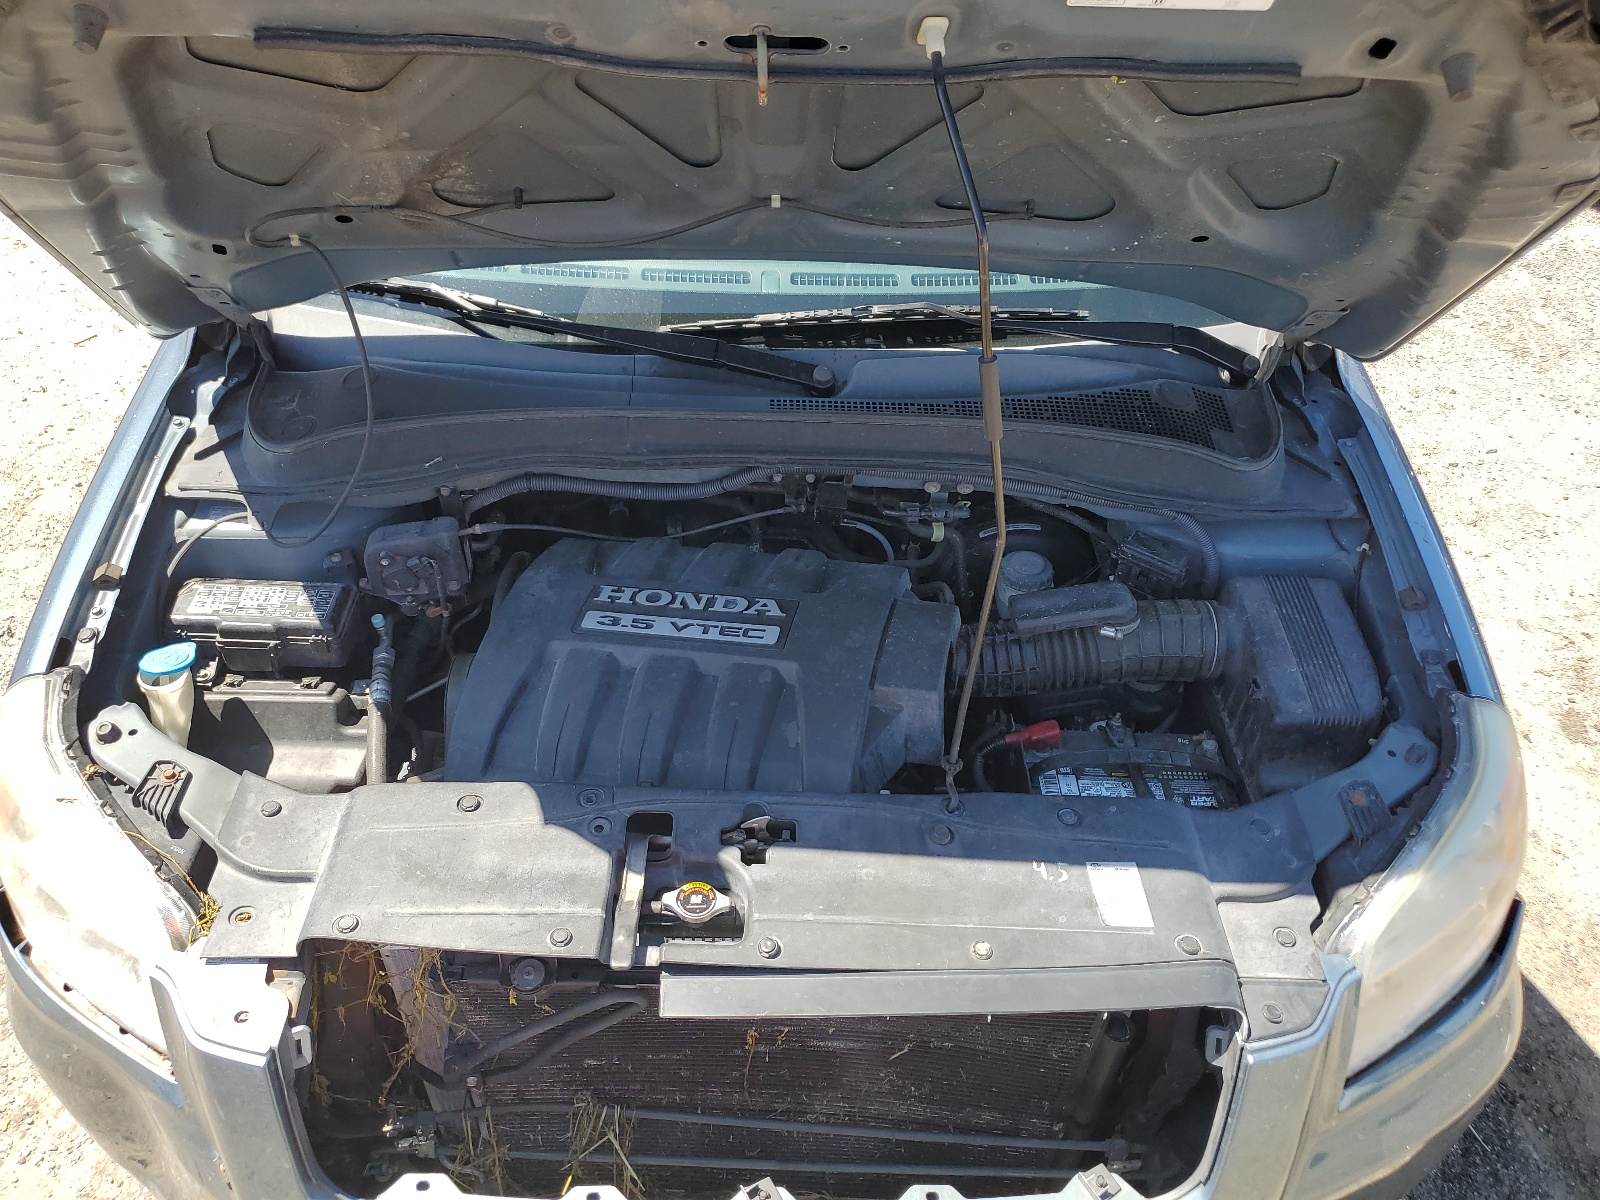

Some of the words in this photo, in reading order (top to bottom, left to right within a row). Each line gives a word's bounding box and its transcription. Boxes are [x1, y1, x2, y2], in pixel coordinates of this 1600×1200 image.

[594, 585, 787, 617] HONDA
[596, 615, 656, 630] 3.5
[670, 621, 767, 640] VTEC
